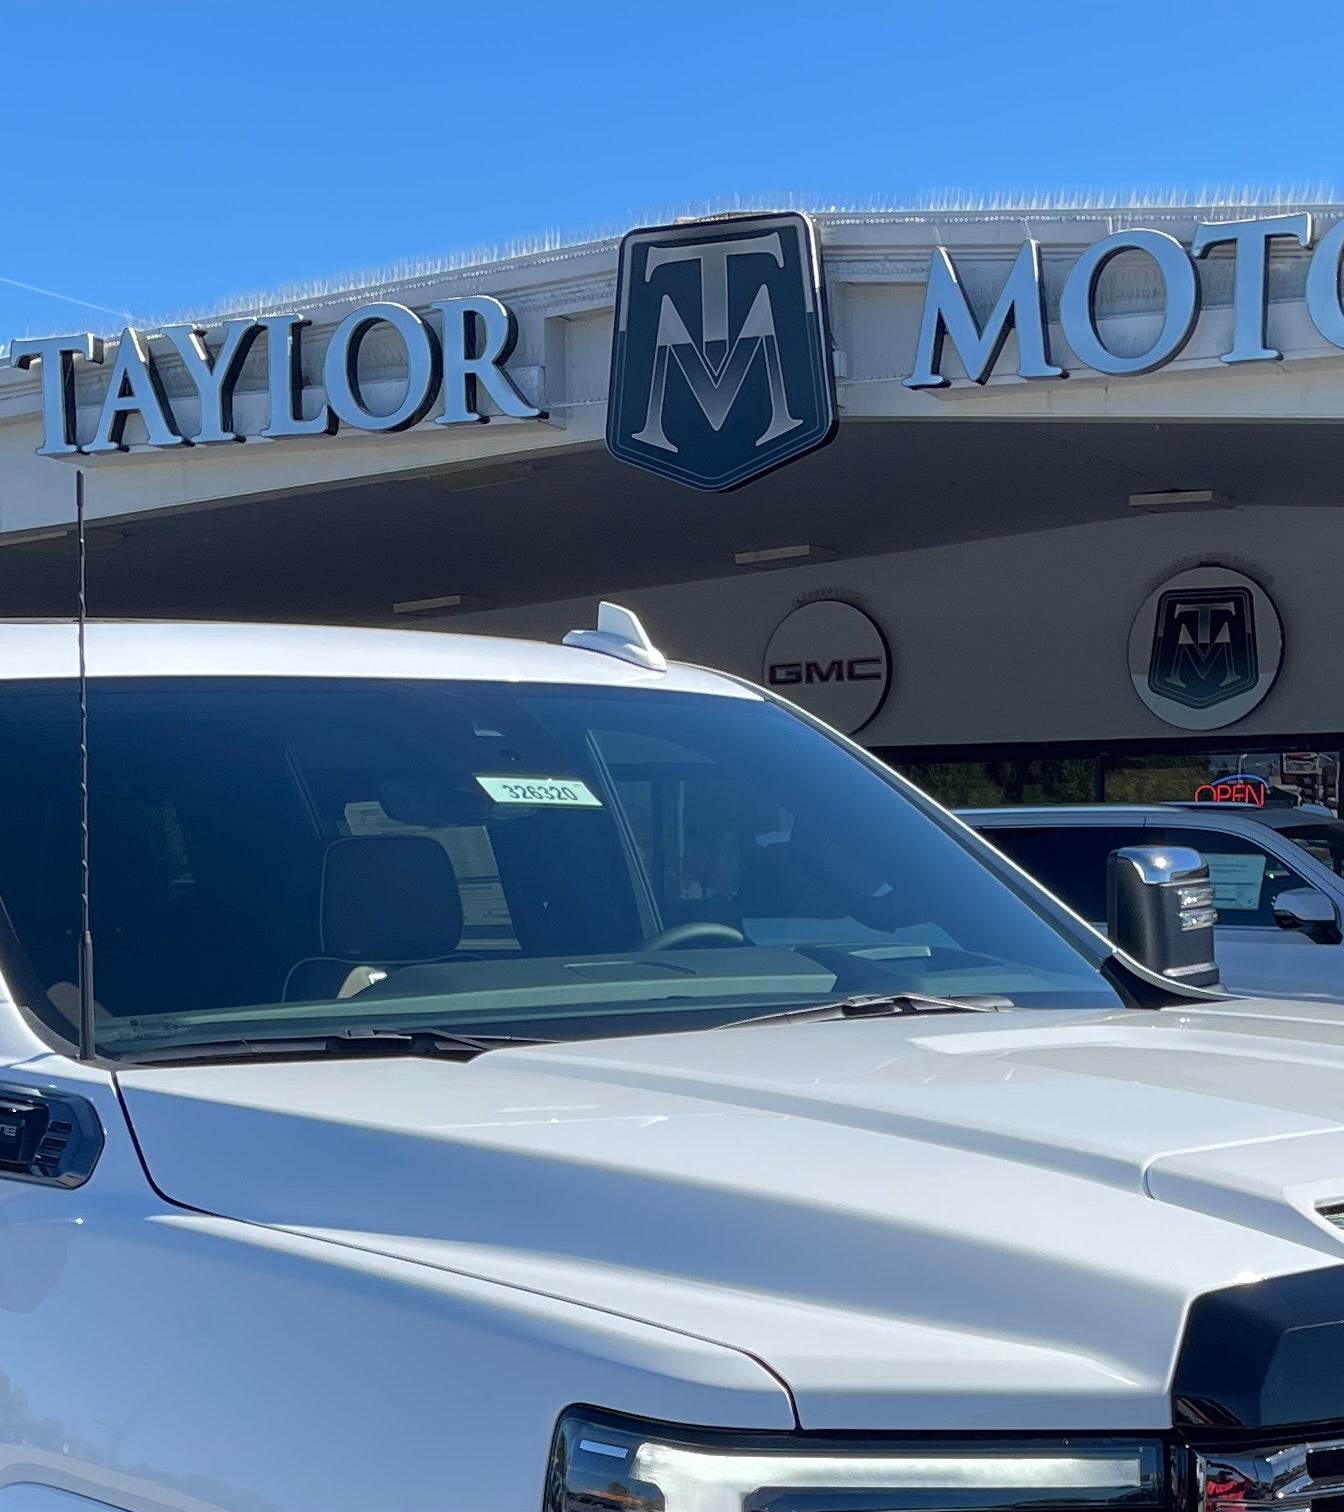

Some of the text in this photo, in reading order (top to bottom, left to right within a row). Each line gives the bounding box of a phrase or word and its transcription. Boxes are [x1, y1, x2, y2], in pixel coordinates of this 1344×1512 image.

[10, 293, 550, 457] TAYLOR
[768, 657, 882, 686] GMC
[502, 784, 578, 801] 326320
[1194, 783, 1265, 807] OPEN
